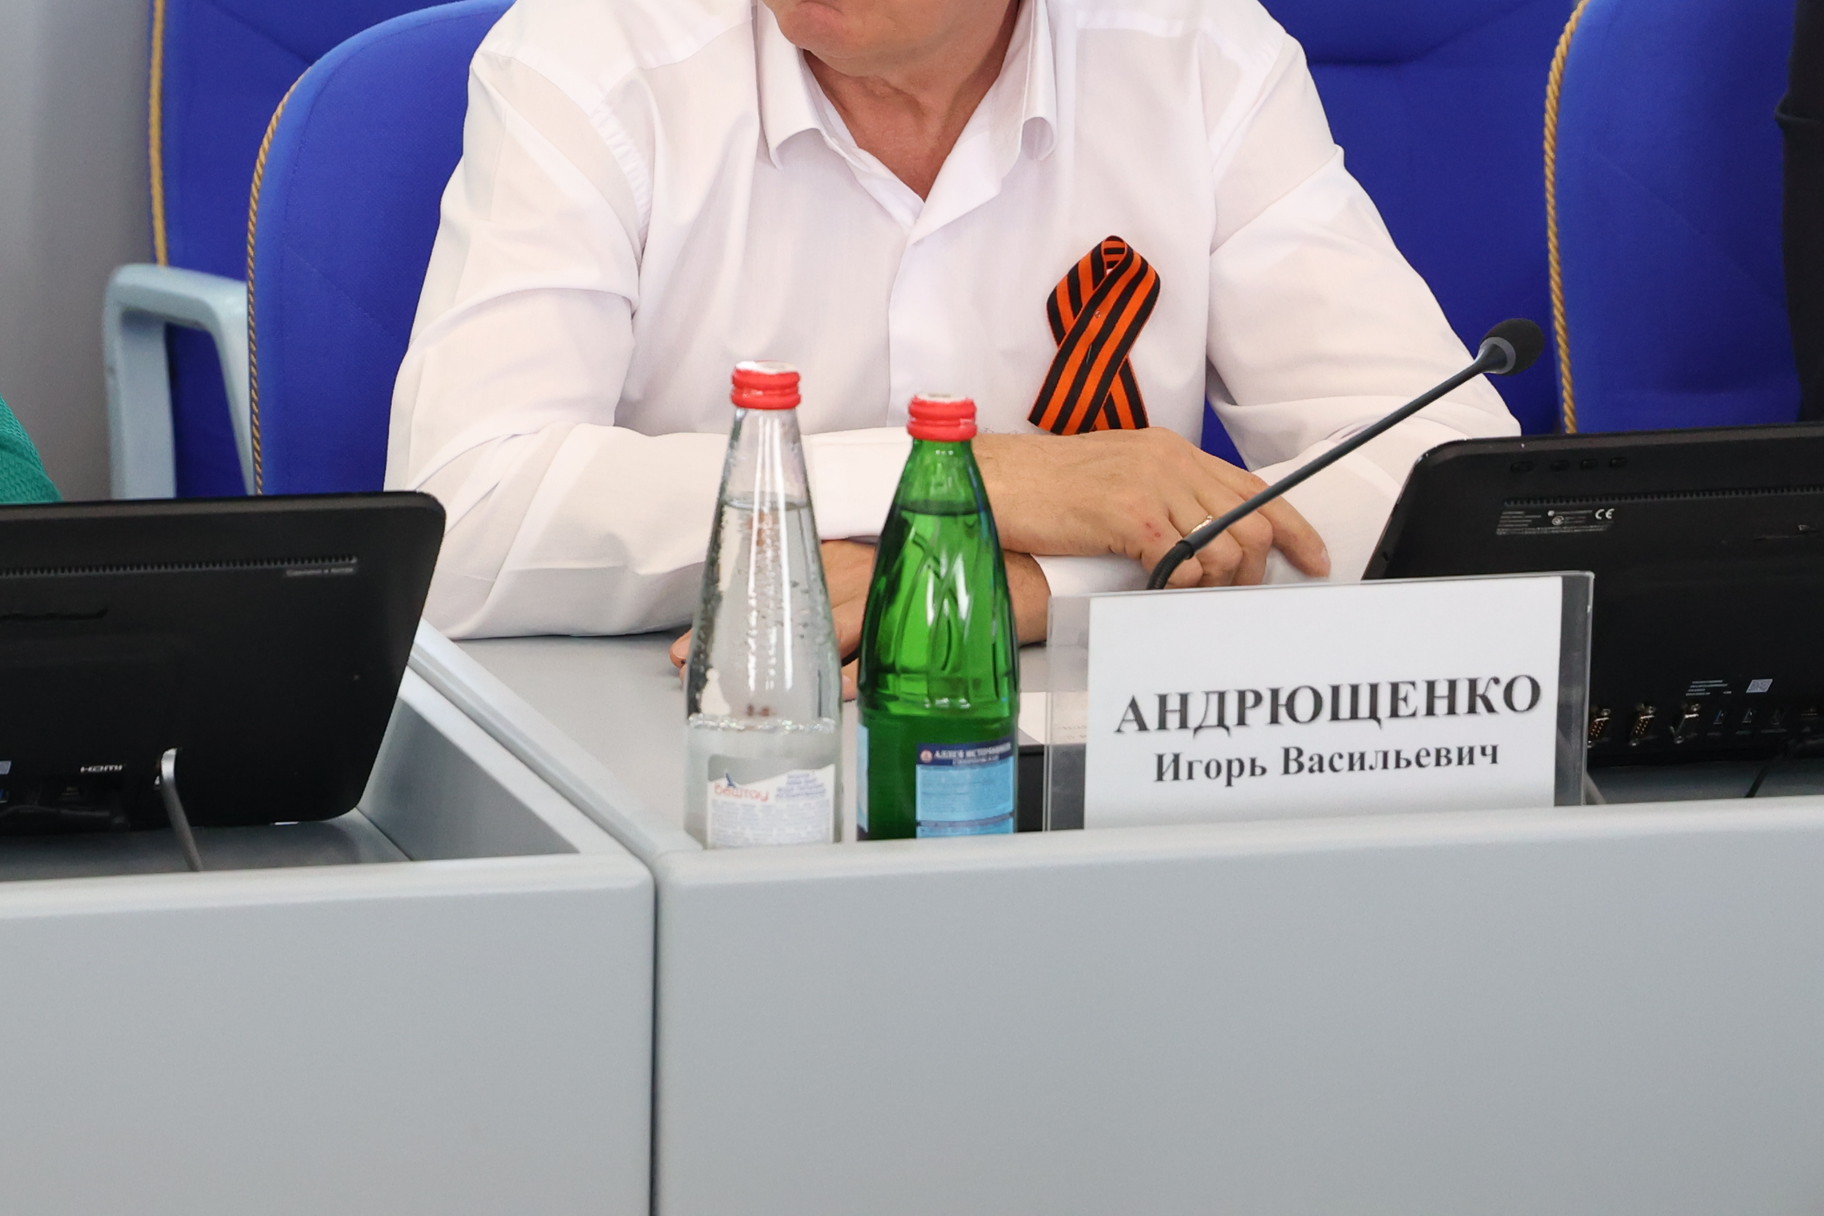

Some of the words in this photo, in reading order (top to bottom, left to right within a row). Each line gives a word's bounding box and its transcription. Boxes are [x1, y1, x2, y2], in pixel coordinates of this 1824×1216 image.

[1114, 674, 1542, 737] АНДРЮЩЕНКО
[1153, 752, 1268, 788] Игорь
[1280, 744, 1499, 777] Васильевич
